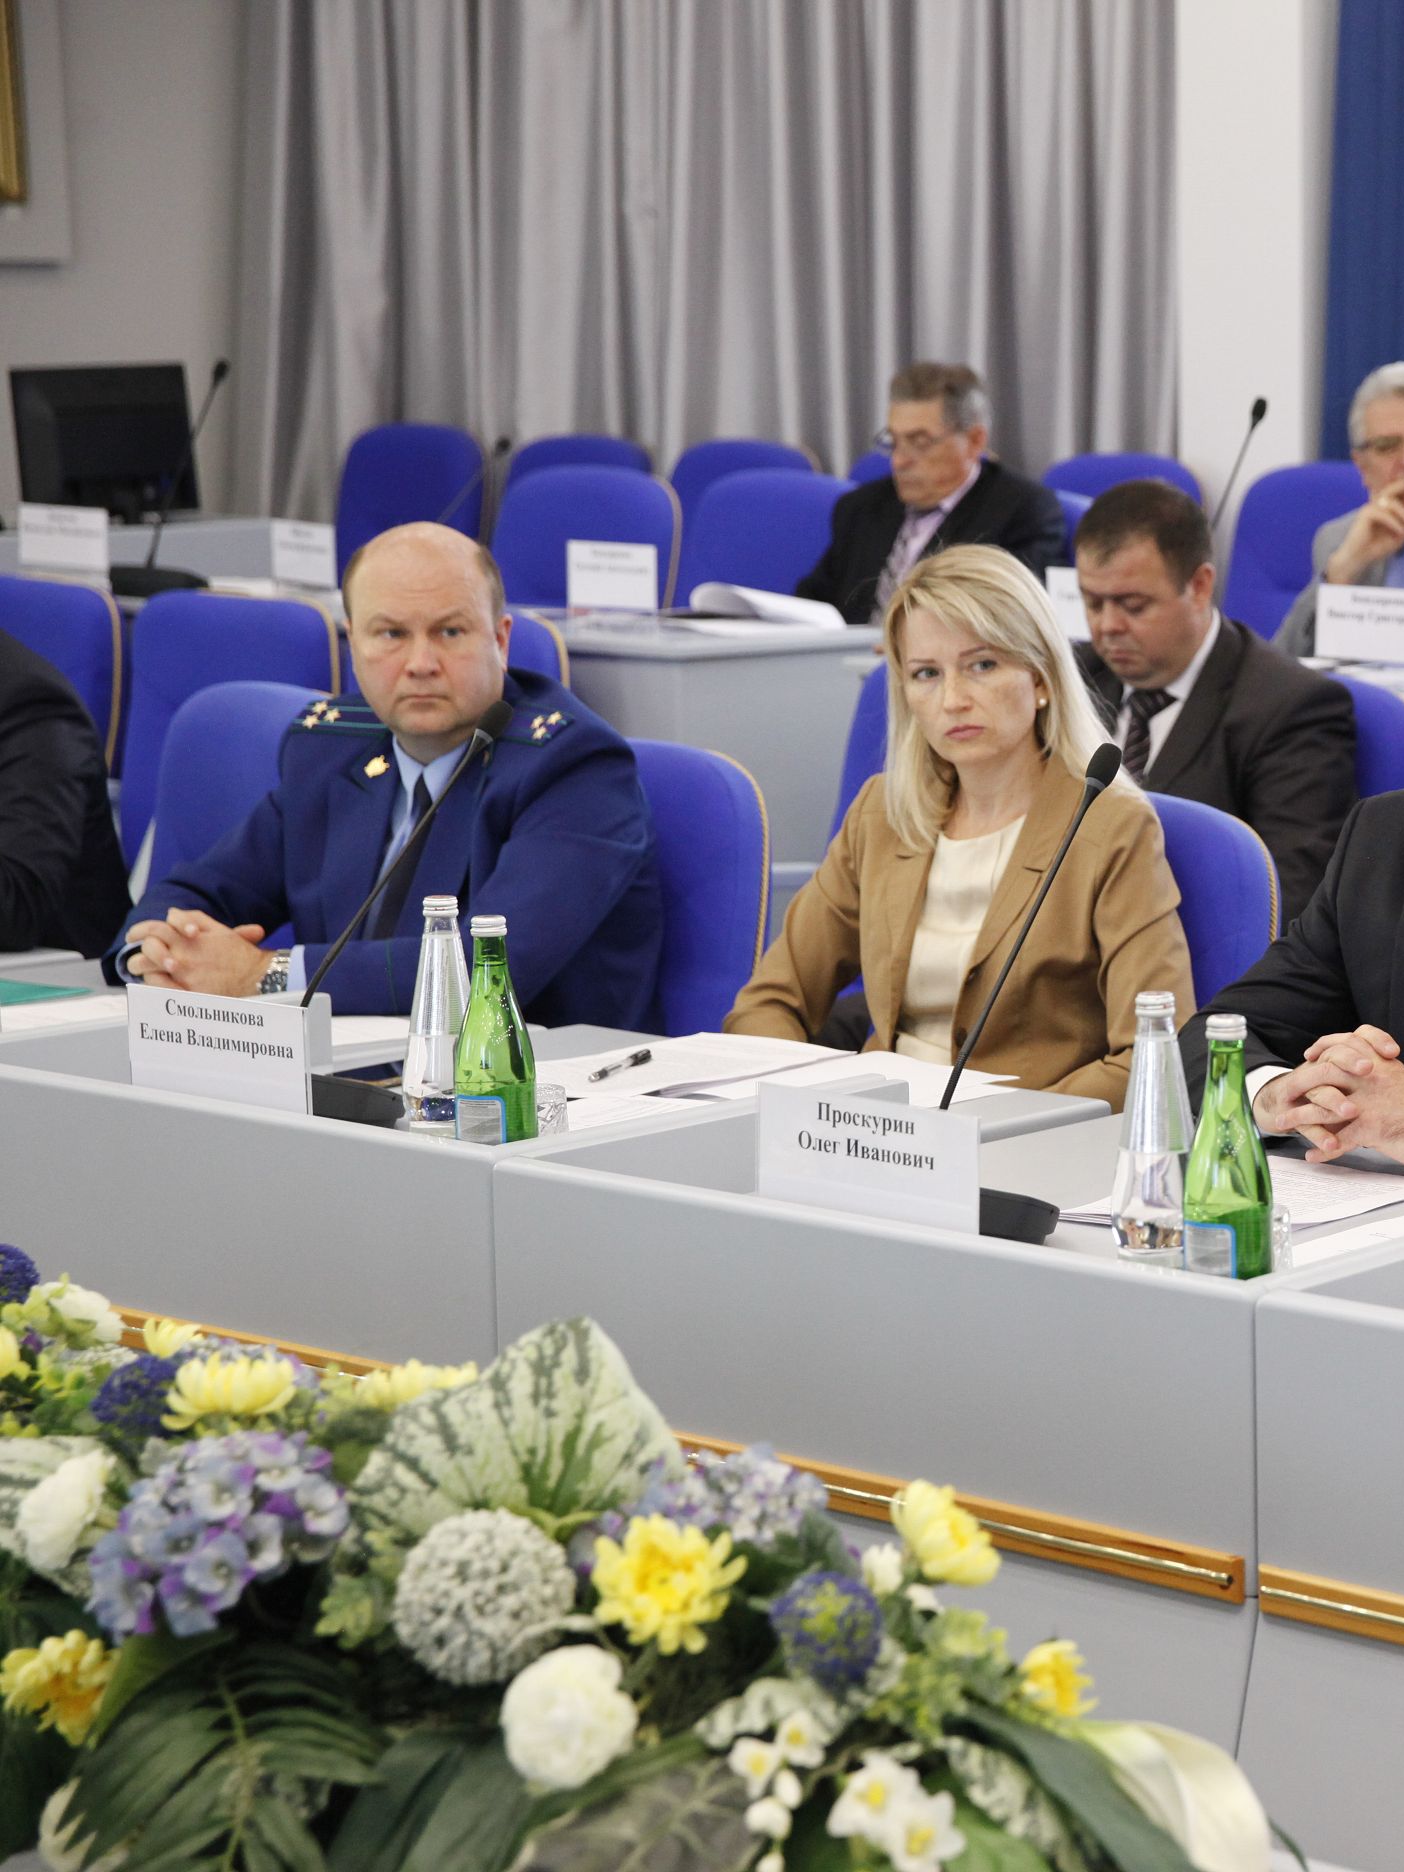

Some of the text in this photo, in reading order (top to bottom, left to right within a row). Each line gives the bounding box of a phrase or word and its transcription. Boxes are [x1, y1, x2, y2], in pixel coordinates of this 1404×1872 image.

[165, 998, 264, 1027] Смольникова
[140, 1022, 294, 1060] Елена Владимировна
[817, 1101, 915, 1136] Проскурин
[798, 1130, 935, 1171] Олег Иванович
